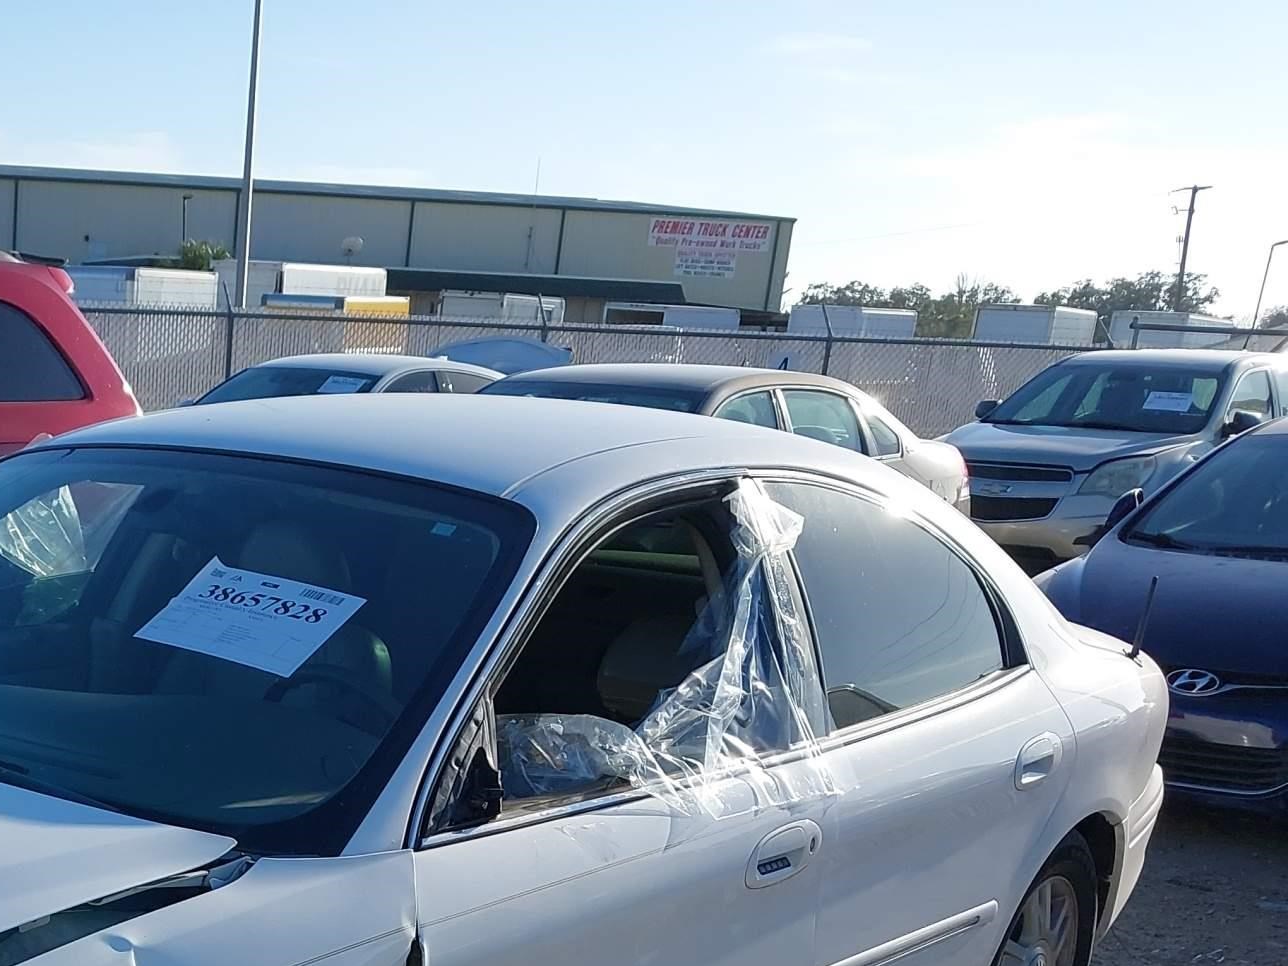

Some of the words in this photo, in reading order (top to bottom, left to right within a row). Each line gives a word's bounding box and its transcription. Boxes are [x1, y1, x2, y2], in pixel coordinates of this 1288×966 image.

[652, 220, 695, 235] PREMIER
[697, 222, 730, 237] TRUCK
[731, 224, 770, 239] CENTER
[198, 584, 328, 624] 38657828
